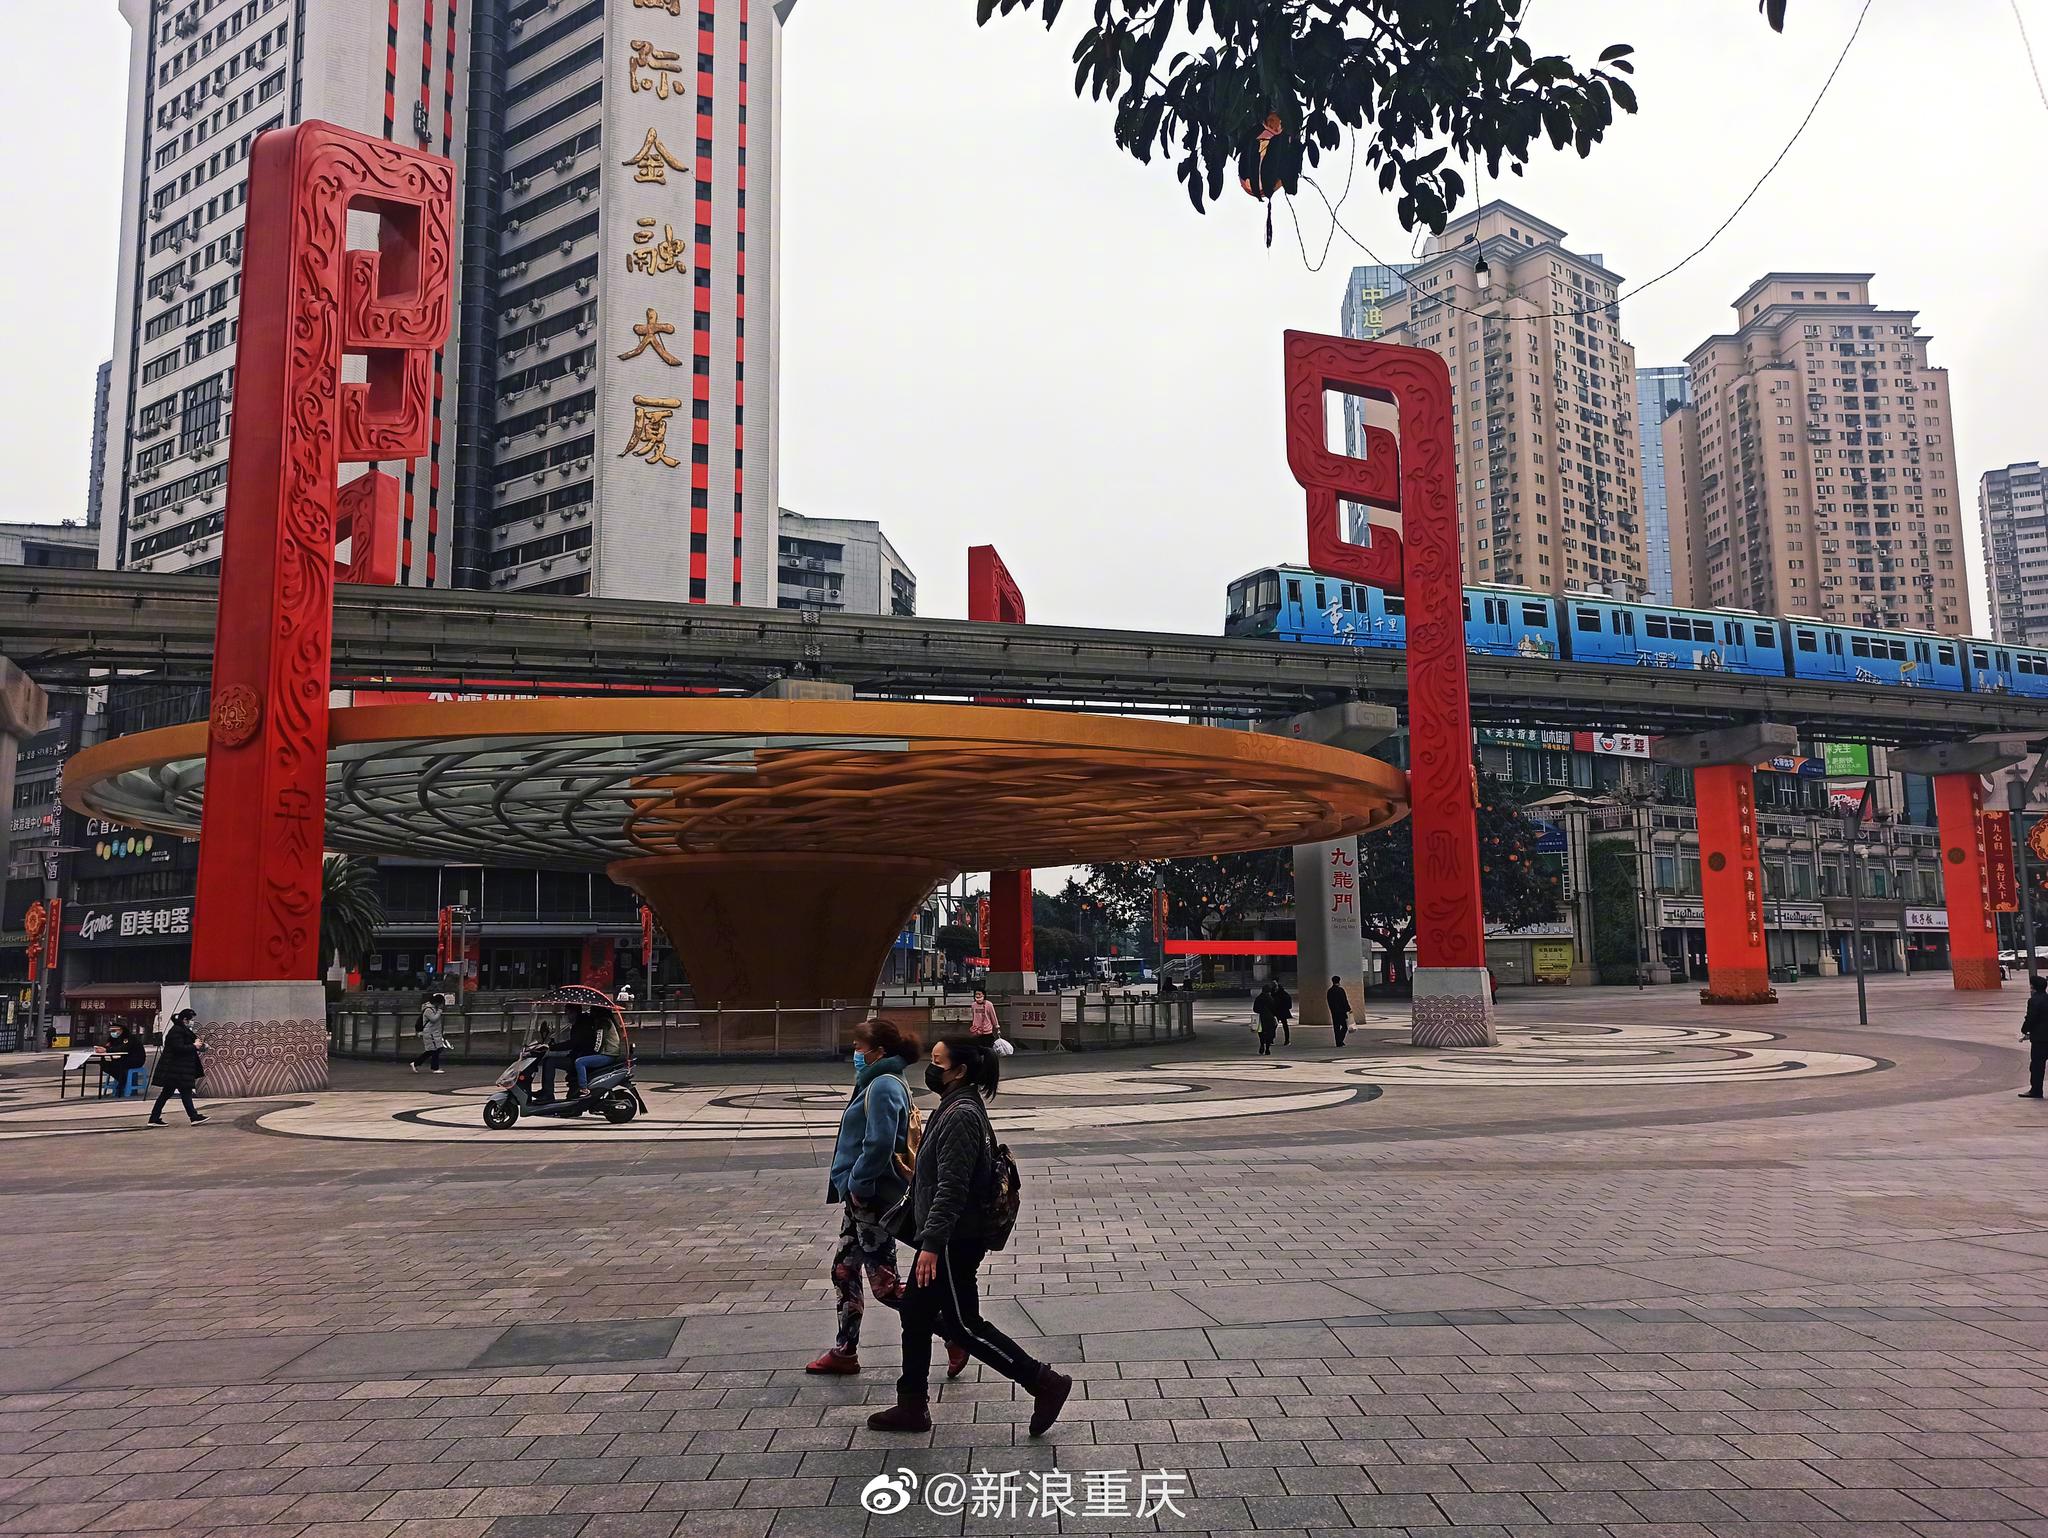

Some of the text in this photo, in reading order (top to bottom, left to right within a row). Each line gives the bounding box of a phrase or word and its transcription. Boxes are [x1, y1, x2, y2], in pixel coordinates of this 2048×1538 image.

[1362, 287, 1383, 339] 中迪
[1359, 615, 1398, 632] 行千里
[1541, 729, 1571, 745] 山木培训
[1331, 847, 1354, 914] 九龍門
[1992, 823, 2007, 900] 九心归一 龙行天下
[119, 907, 190, 936] 国美电器
[1746, 870, 1758, 942] 龙行天下
